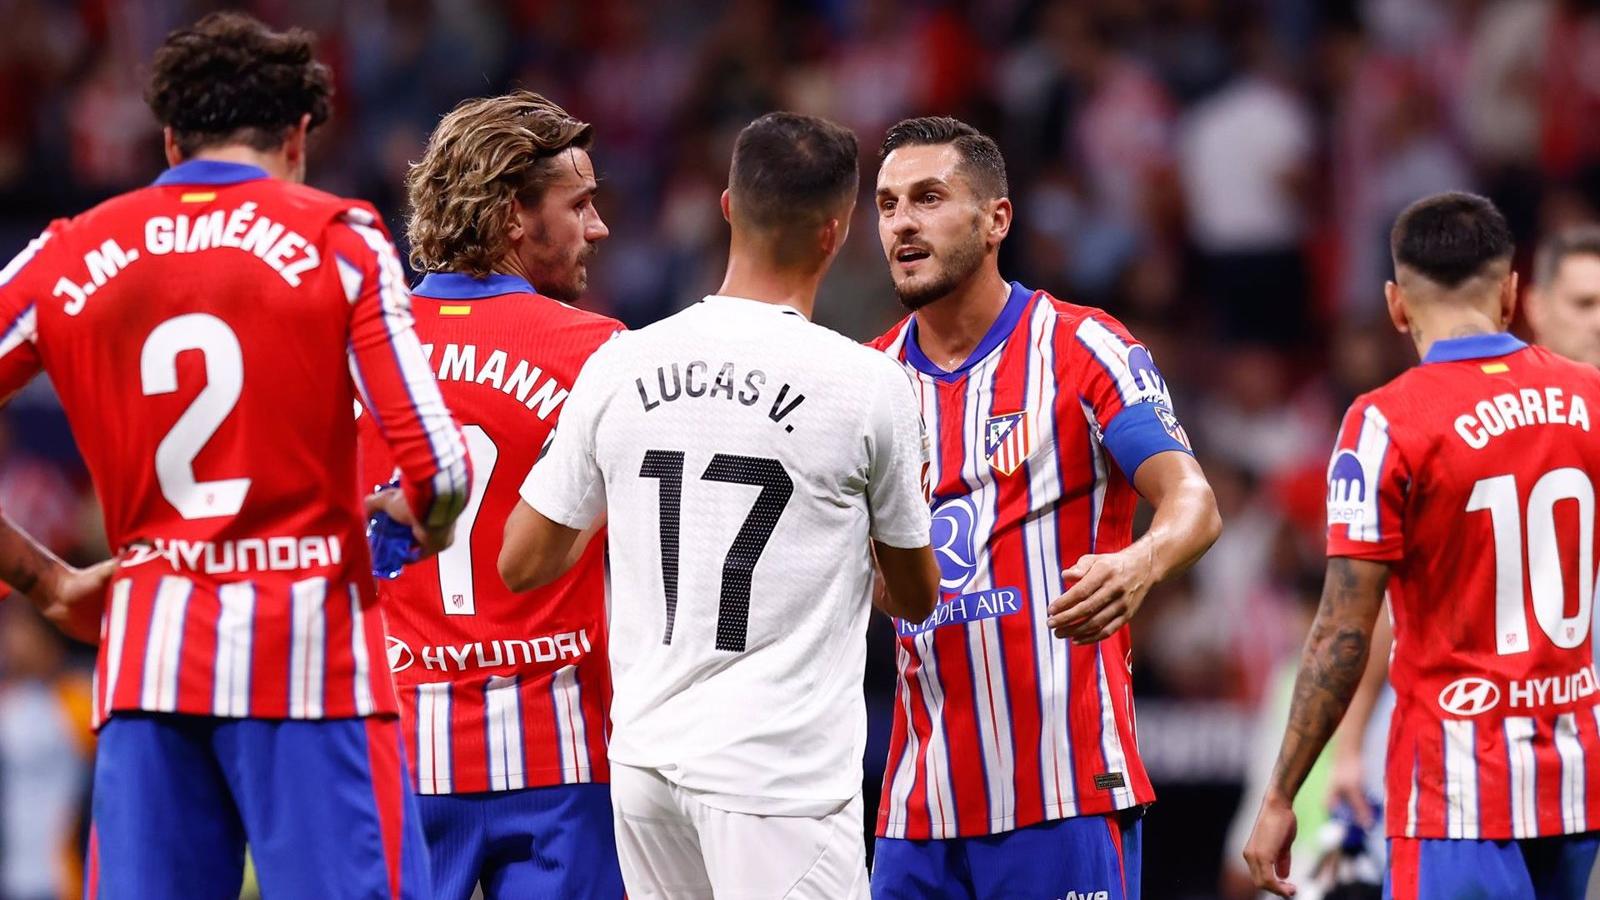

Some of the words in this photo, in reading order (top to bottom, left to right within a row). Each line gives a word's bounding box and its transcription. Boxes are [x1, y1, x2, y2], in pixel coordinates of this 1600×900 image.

[52, 238, 140, 316] J.M.
[144, 201, 321, 288] GIMÉNEZ
[140, 313, 251, 520] 2
[635, 360, 767, 413] LUCAS
[768, 382, 806, 434] V.
[1453, 387, 1591, 450] CORREA
[638, 449, 795, 652] 17
[1465, 467, 1596, 656] 10
[421, 628, 592, 672] HYUNDAI
[975, 590, 1017, 617] AIR
